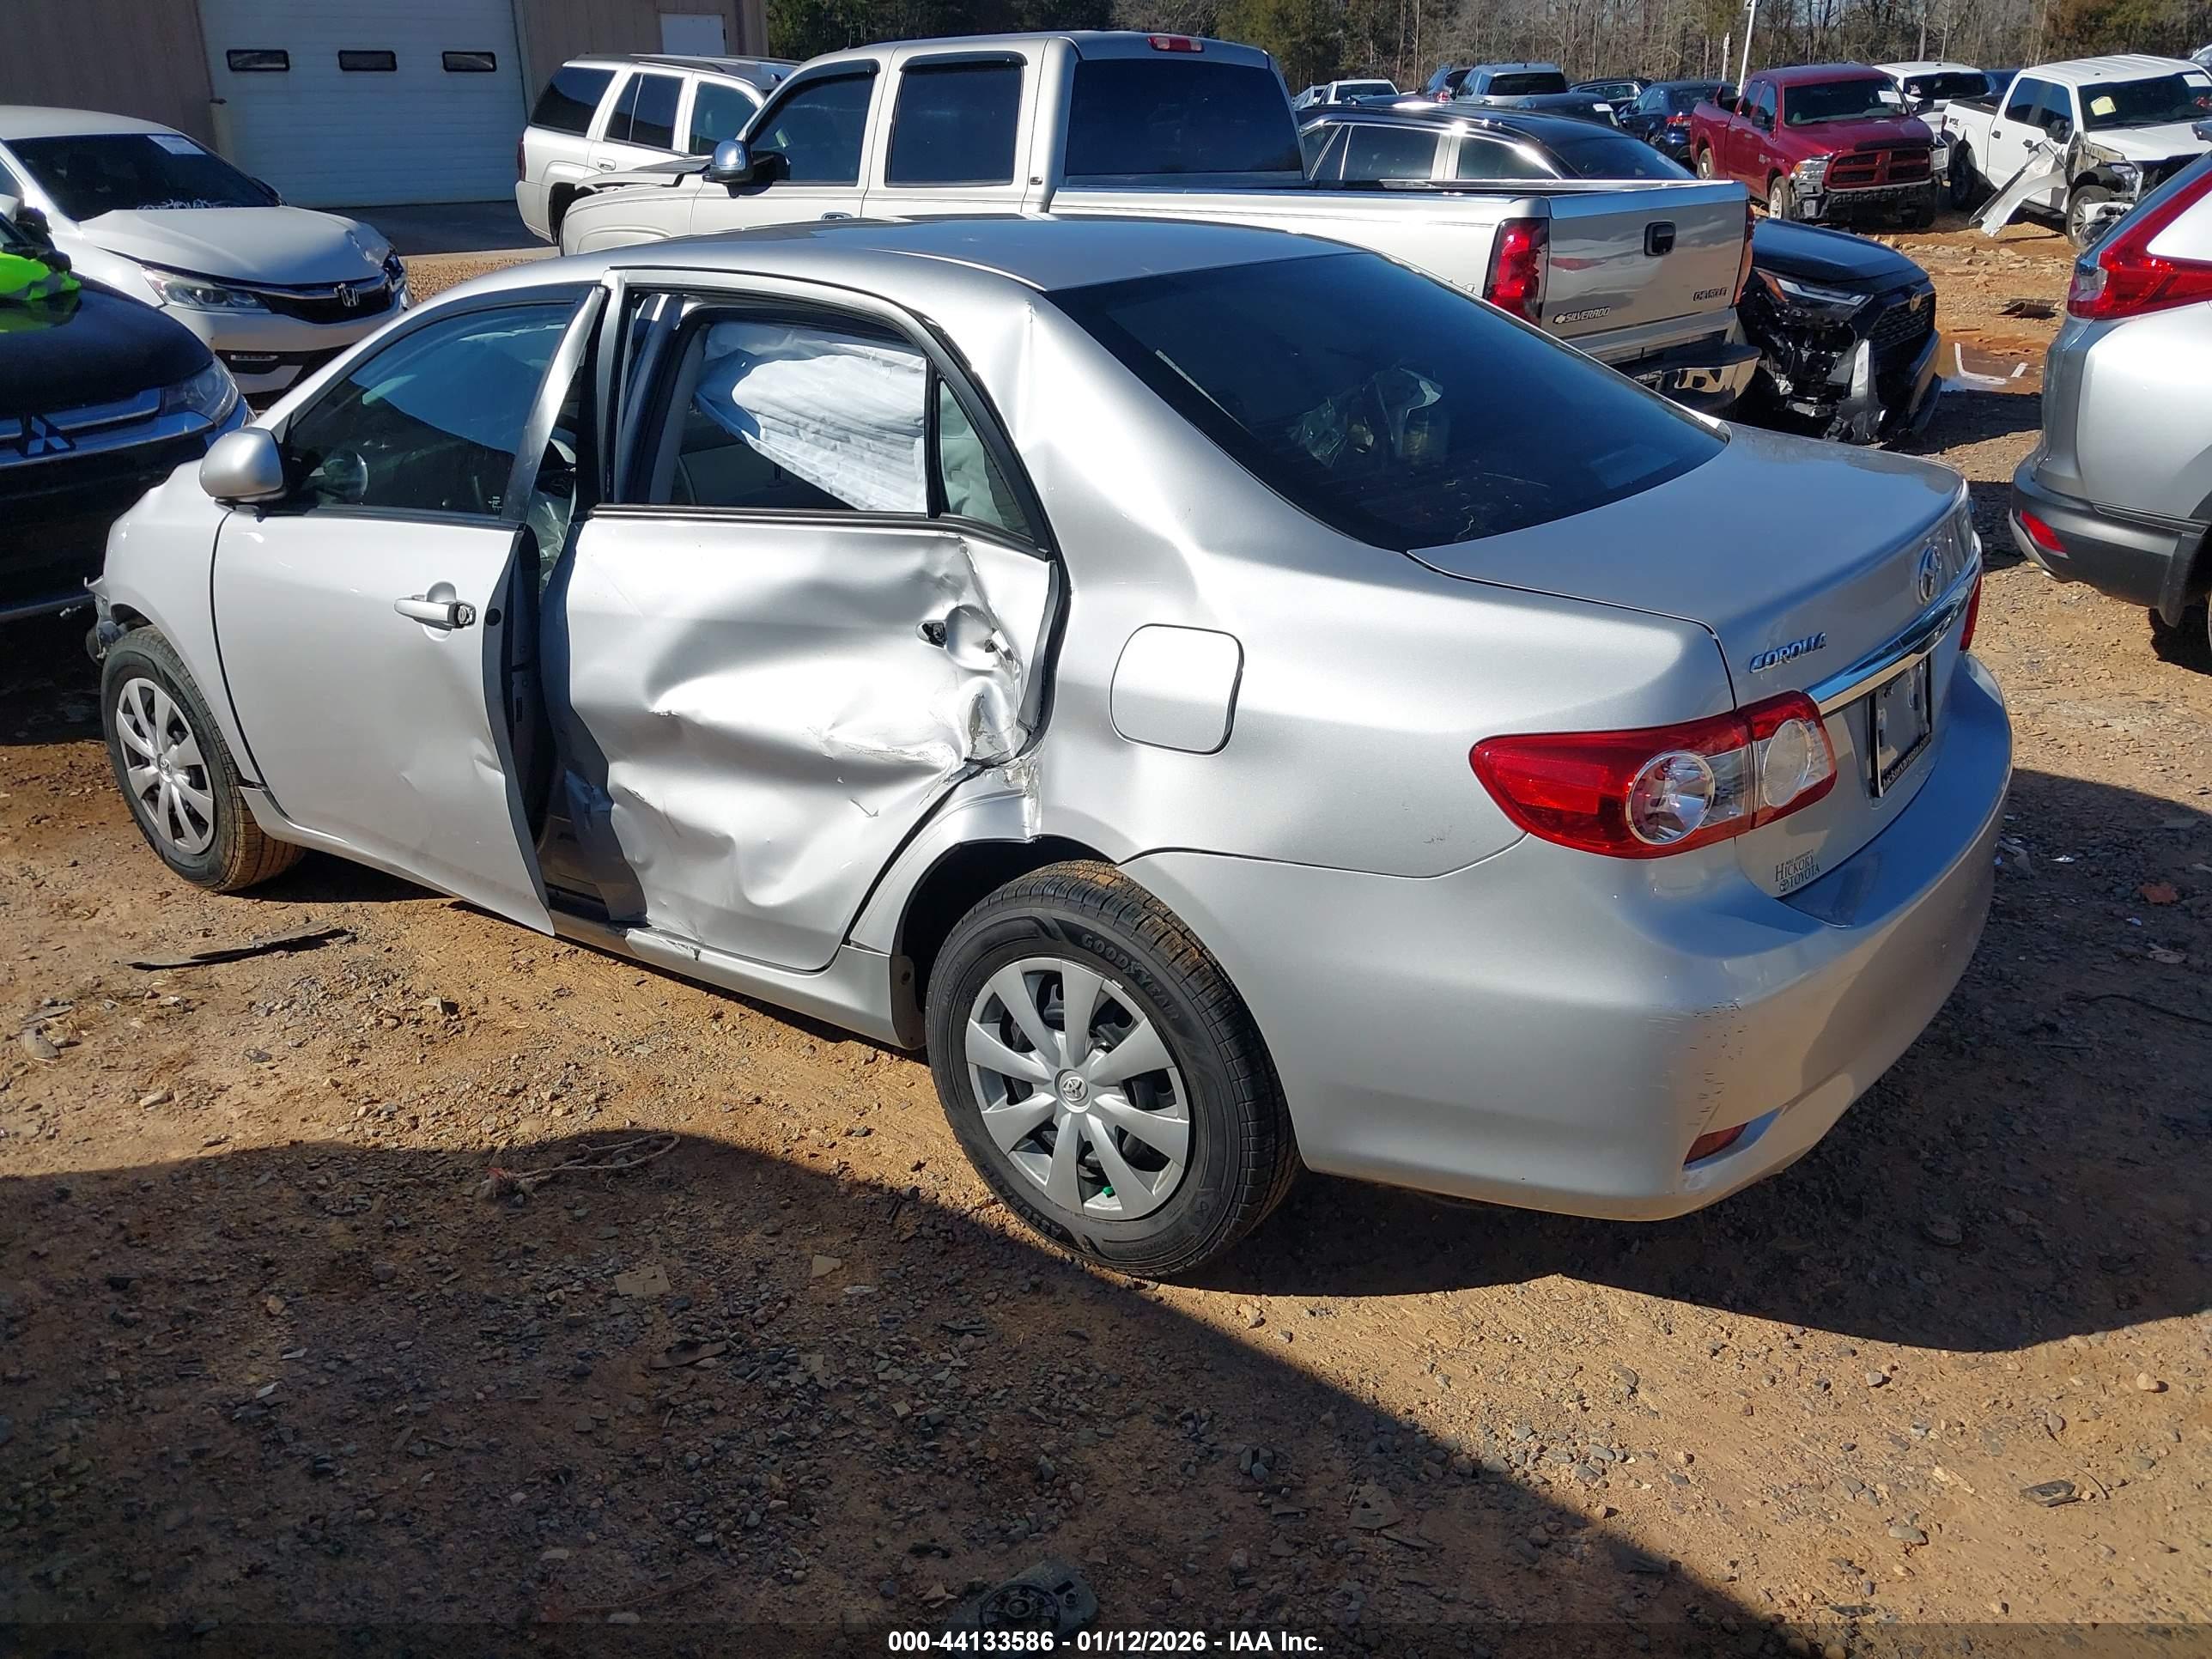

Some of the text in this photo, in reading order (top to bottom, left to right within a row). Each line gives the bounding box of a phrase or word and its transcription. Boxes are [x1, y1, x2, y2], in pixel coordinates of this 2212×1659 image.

[1565, 307, 1611, 324] SILVERADO
[1749, 631, 1827, 673] COROLLA
[1775, 854, 1814, 883] HICKORY
[1790, 863, 1820, 888] TOYOTA
